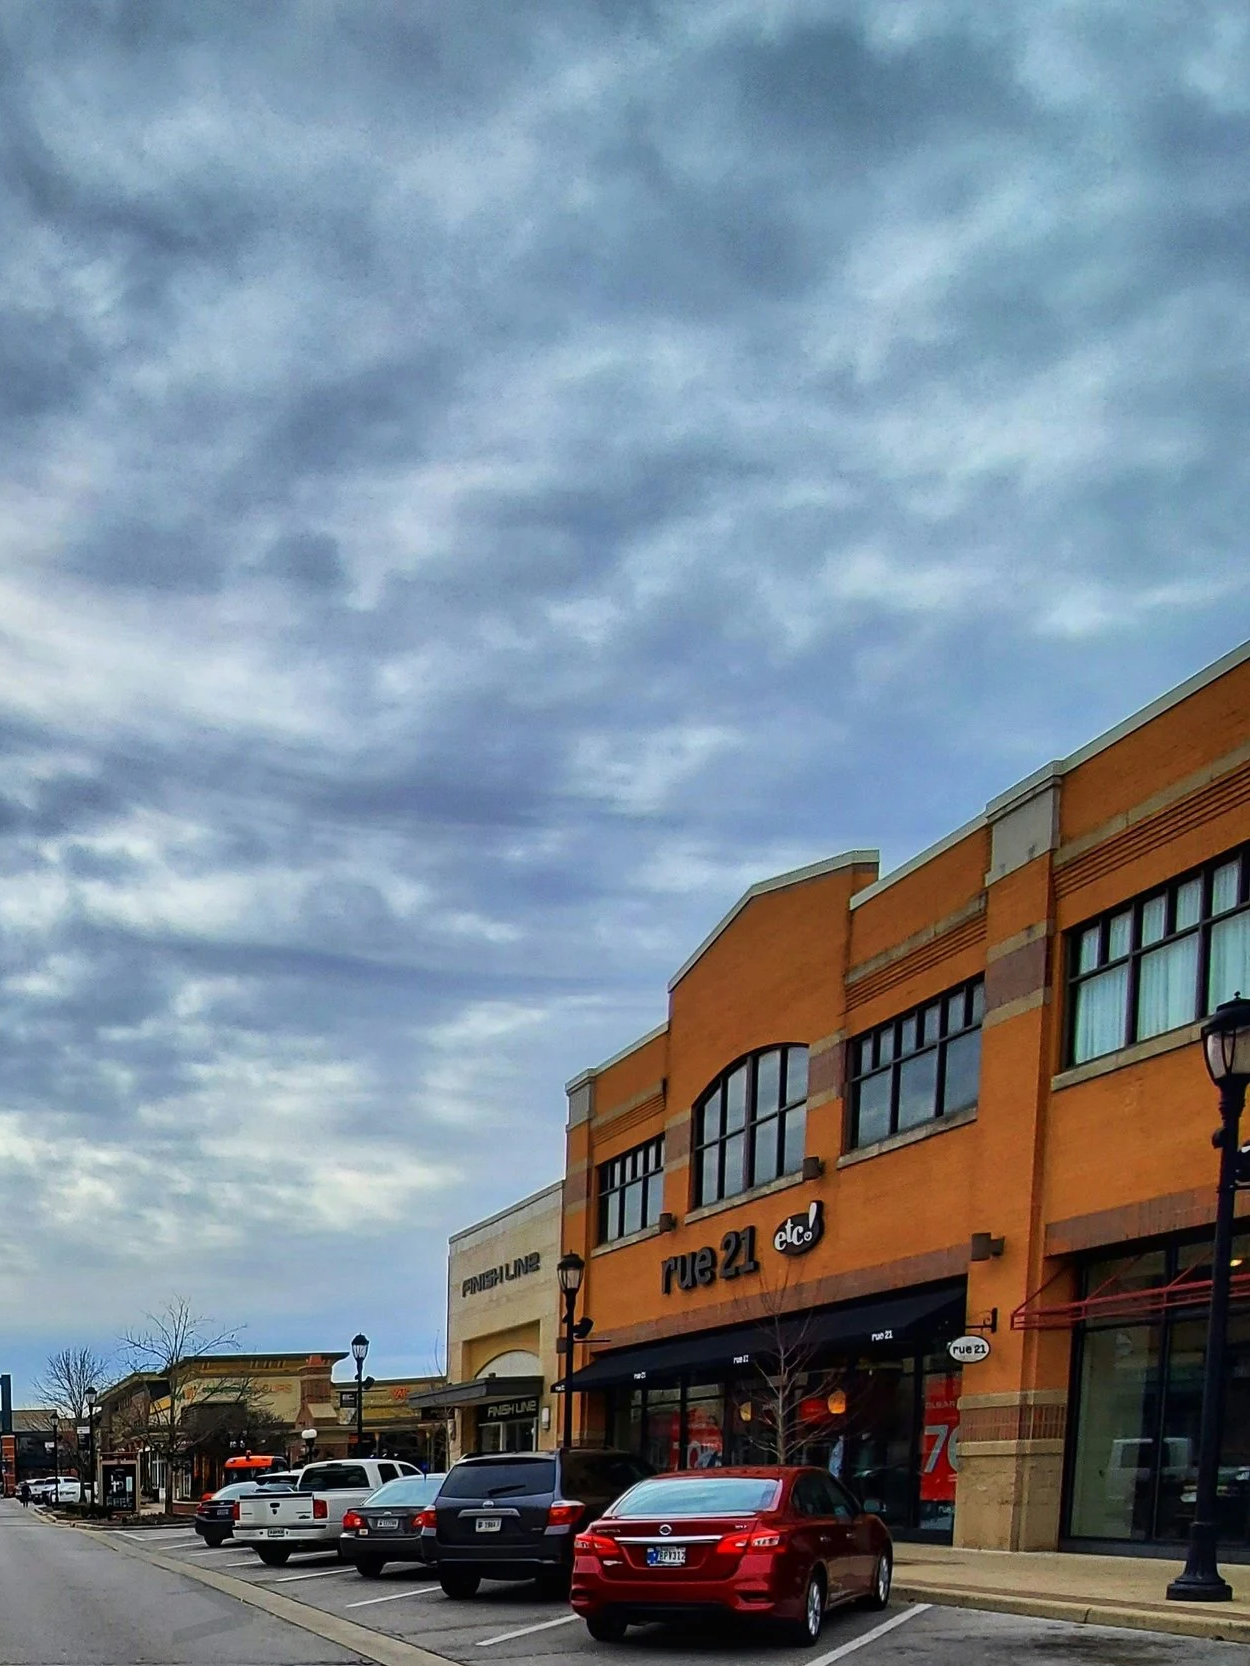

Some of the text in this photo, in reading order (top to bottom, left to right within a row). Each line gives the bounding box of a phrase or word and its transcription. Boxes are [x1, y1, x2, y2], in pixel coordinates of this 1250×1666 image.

[661, 1225, 760, 1295] rue 21
[462, 1252, 540, 1297] FINISH LINE
[871, 1330, 893, 1341] rue 21
[953, 1344, 986, 1354] rue 21
